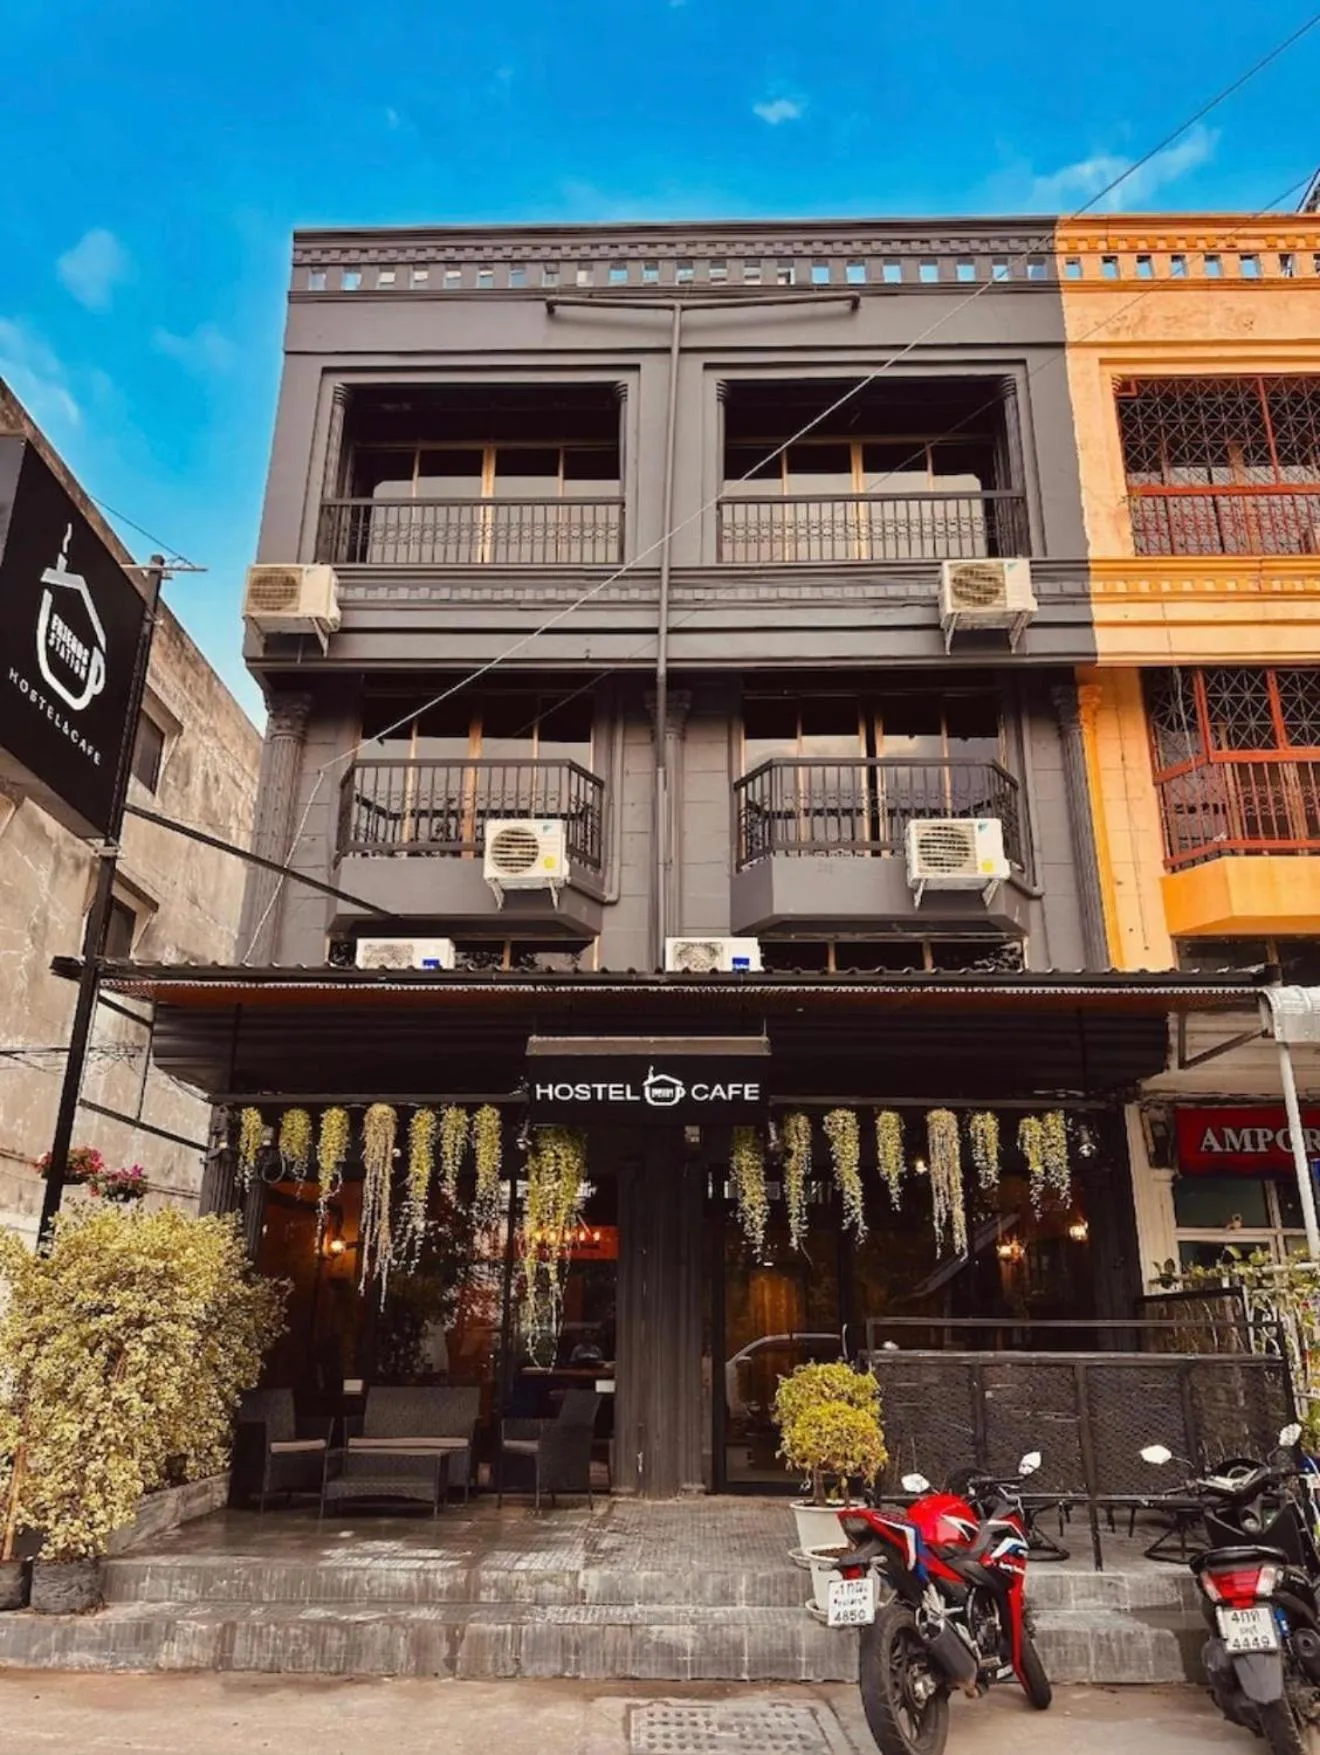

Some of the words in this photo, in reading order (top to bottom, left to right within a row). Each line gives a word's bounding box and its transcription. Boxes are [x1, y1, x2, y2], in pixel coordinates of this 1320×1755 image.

[48, 631, 87, 682] STATION
[536, 1084, 640, 1101] HOSTEL
[691, 1084, 760, 1101] CAFE
